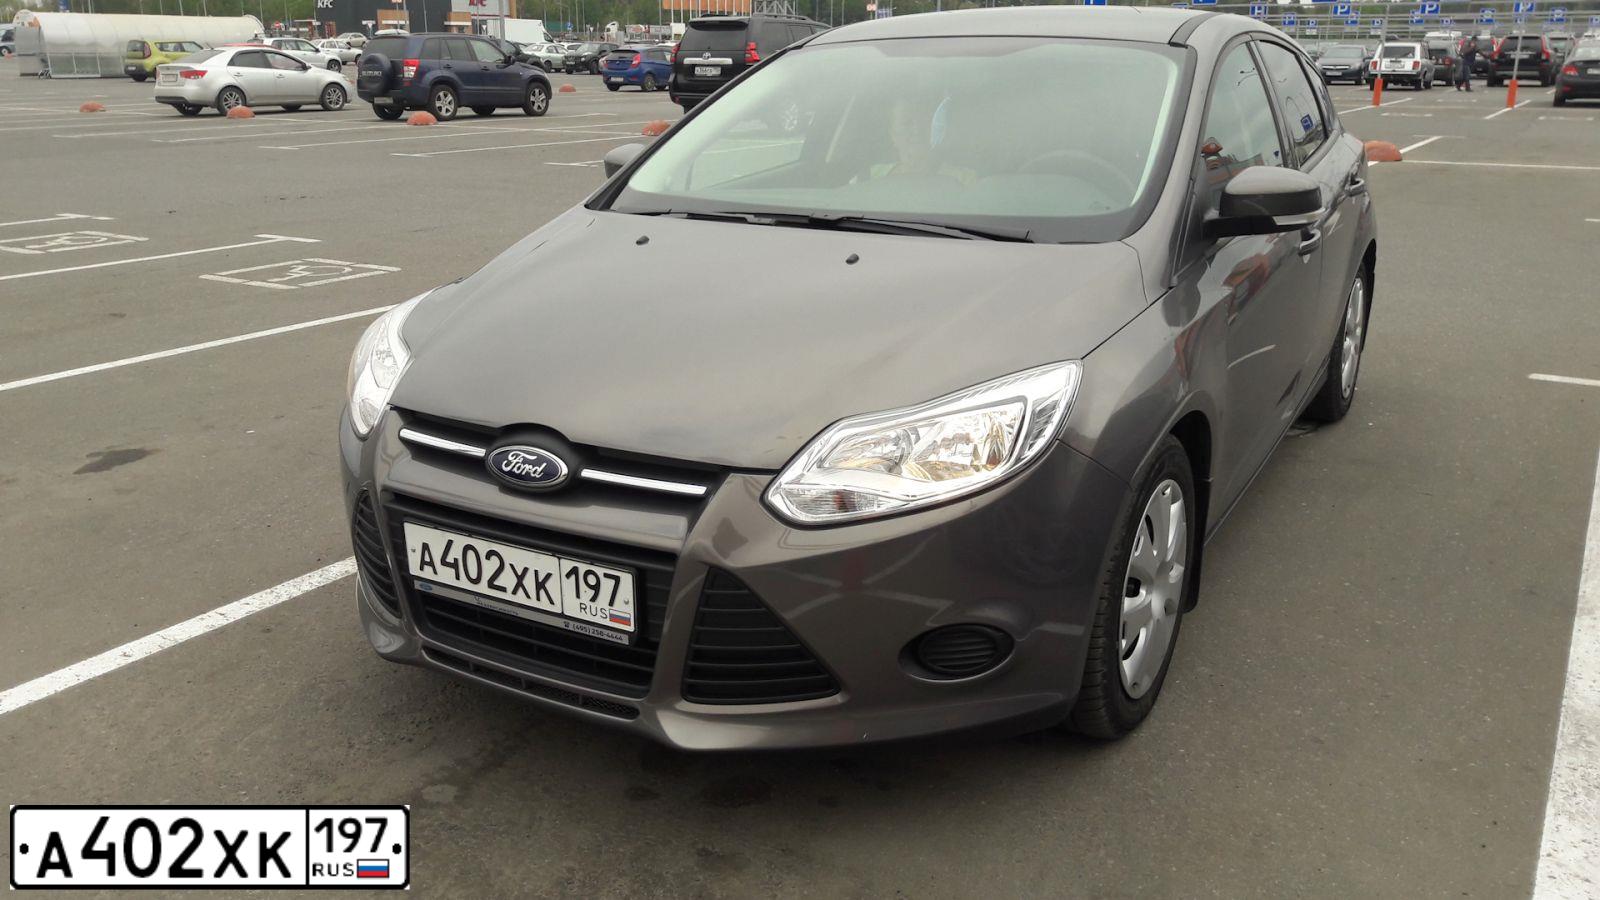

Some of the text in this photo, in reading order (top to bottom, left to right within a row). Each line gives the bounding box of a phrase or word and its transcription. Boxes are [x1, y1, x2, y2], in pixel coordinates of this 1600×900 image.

[316, 0, 334, 8] KFC
[501, 450, 547, 478] Ford
[418, 539, 556, 606] A402XK
[565, 565, 621, 607] 197
[580, 602, 608, 620] RUS
